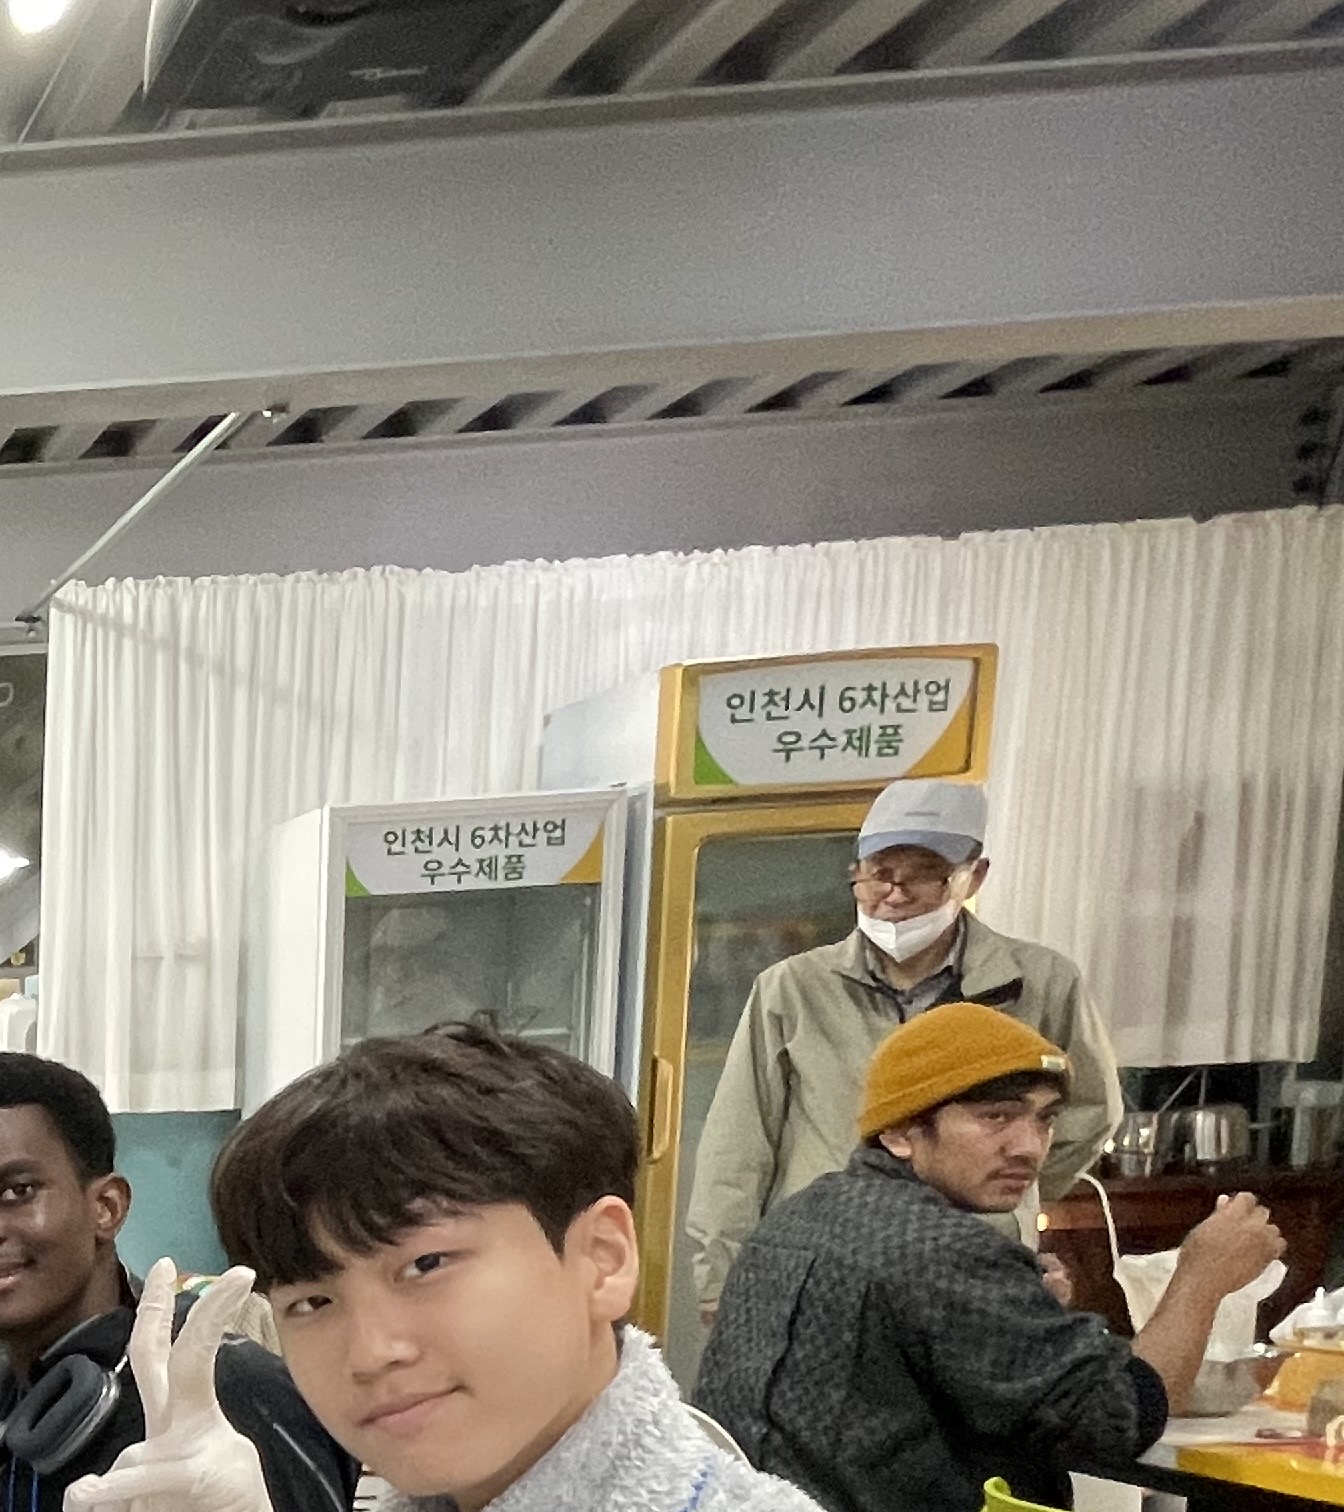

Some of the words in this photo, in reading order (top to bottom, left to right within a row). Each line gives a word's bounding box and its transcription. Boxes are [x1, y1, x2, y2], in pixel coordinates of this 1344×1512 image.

[725, 684, 826, 725] 인천시
[838, 678, 952, 715] 6차산업
[771, 723, 905, 763] 우수제품
[383, 825, 461, 856] 인천시
[470, 818, 567, 850] 6차산업
[420, 854, 526, 886] 우수제품
